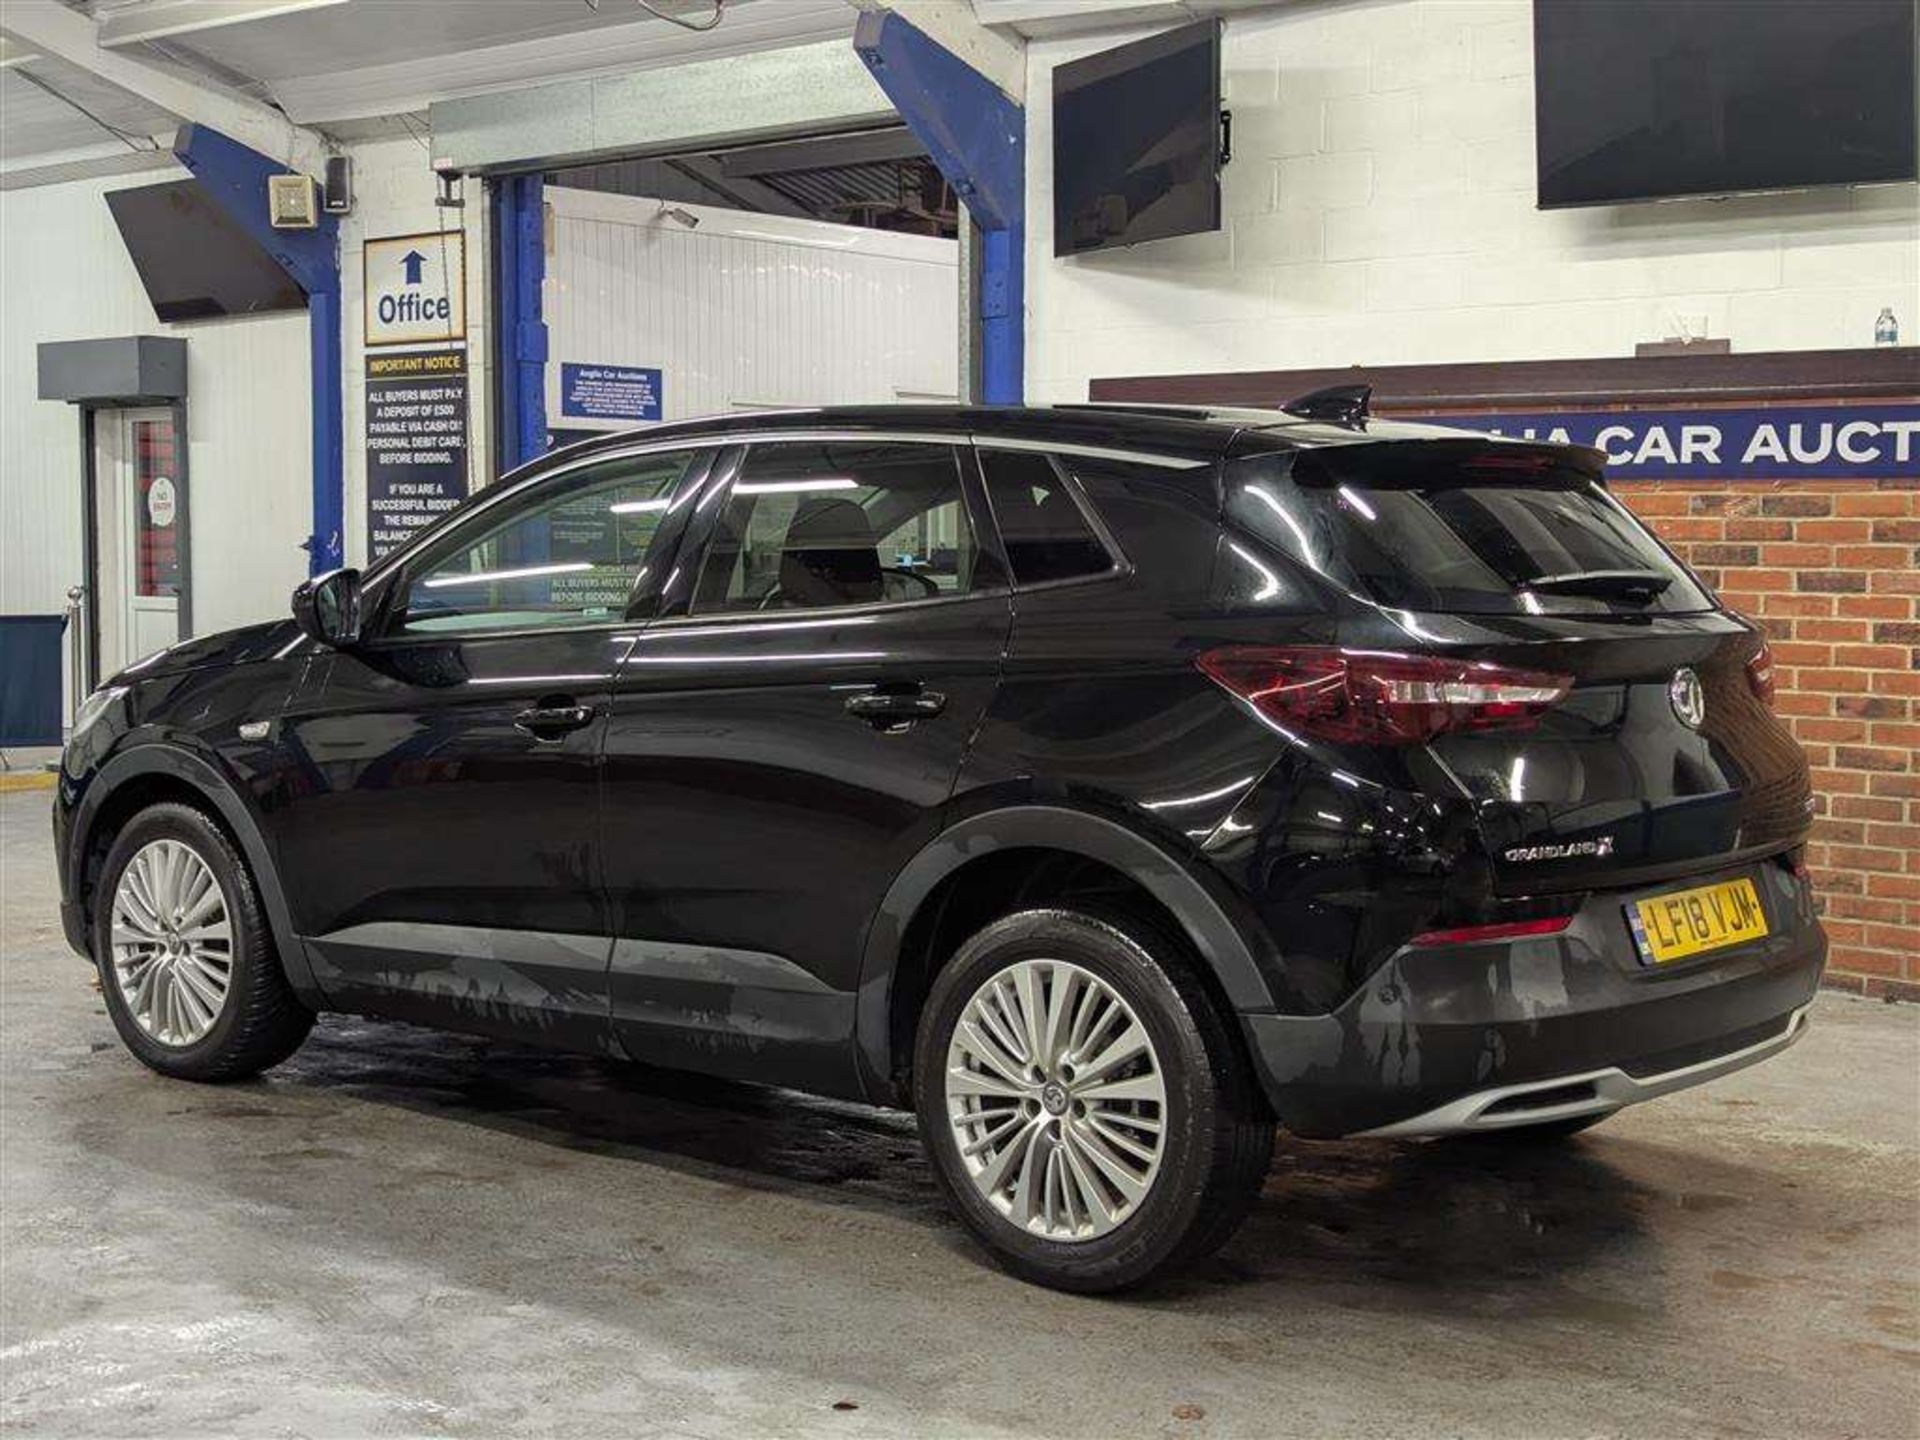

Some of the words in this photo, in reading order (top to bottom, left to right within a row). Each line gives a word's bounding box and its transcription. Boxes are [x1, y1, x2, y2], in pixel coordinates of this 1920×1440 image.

[379, 293, 450, 324] Office
[370, 358, 422, 372] IMPORTANT
[425, 355, 461, 369] NOTICE
[603, 370, 615, 379] Car
[369, 391, 384, 402] ALL
[385, 389, 419, 401] BUYERS
[420, 388, 443, 400] MUST
[376, 408, 383, 418] A
[384, 406, 420, 418] DEPOSIT
[421, 405, 433, 416] OF
[369, 421, 408, 433] PAYABLE
[408, 421, 422, 432] VIA
[424, 420, 448, 432] CASH
[367, 437, 411, 449] PERSONAL
[412, 436, 438, 448] DEBIT
[1595, 425, 1723, 466] CAR
[1741, 420, 1920, 464] AUCT
[380, 452, 412, 464] BEFORE
[389, 484, 398, 495] IF
[398, 484, 417, 495] YOU
[418, 484, 435, 495] ARE
[436, 483, 444, 495] A
[372, 499, 426, 511] SUCCESSFUL
[384, 514, 401, 526] THE
[1505, 842, 1596, 861] GRANDLAND
[1646, 896, 1710, 947] LF18
[1707, 886, 1758, 934] VJM
